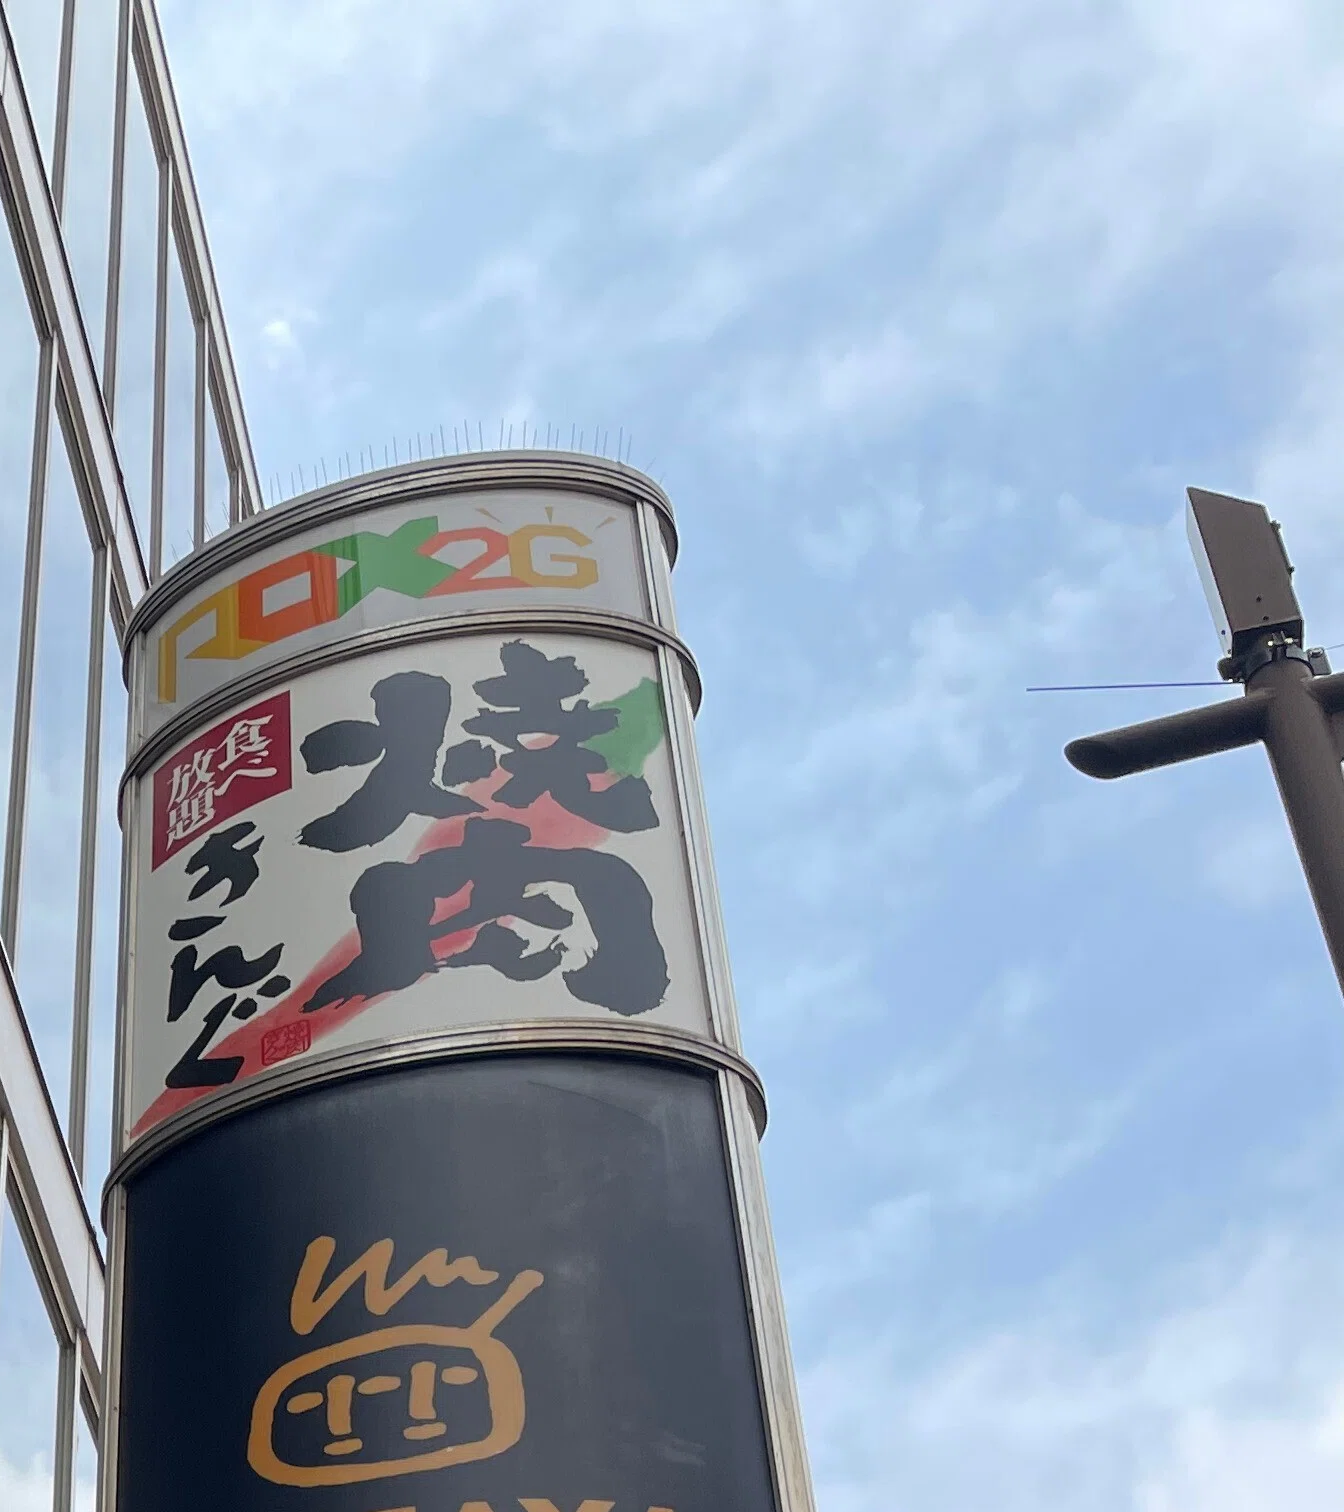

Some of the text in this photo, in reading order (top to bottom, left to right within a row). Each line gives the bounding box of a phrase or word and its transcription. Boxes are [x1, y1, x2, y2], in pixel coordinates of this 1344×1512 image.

[157, 514, 600, 705] ROX2G
[165, 821, 293, 1089] きんぐ
[296, 638, 672, 1017] 焼肉
